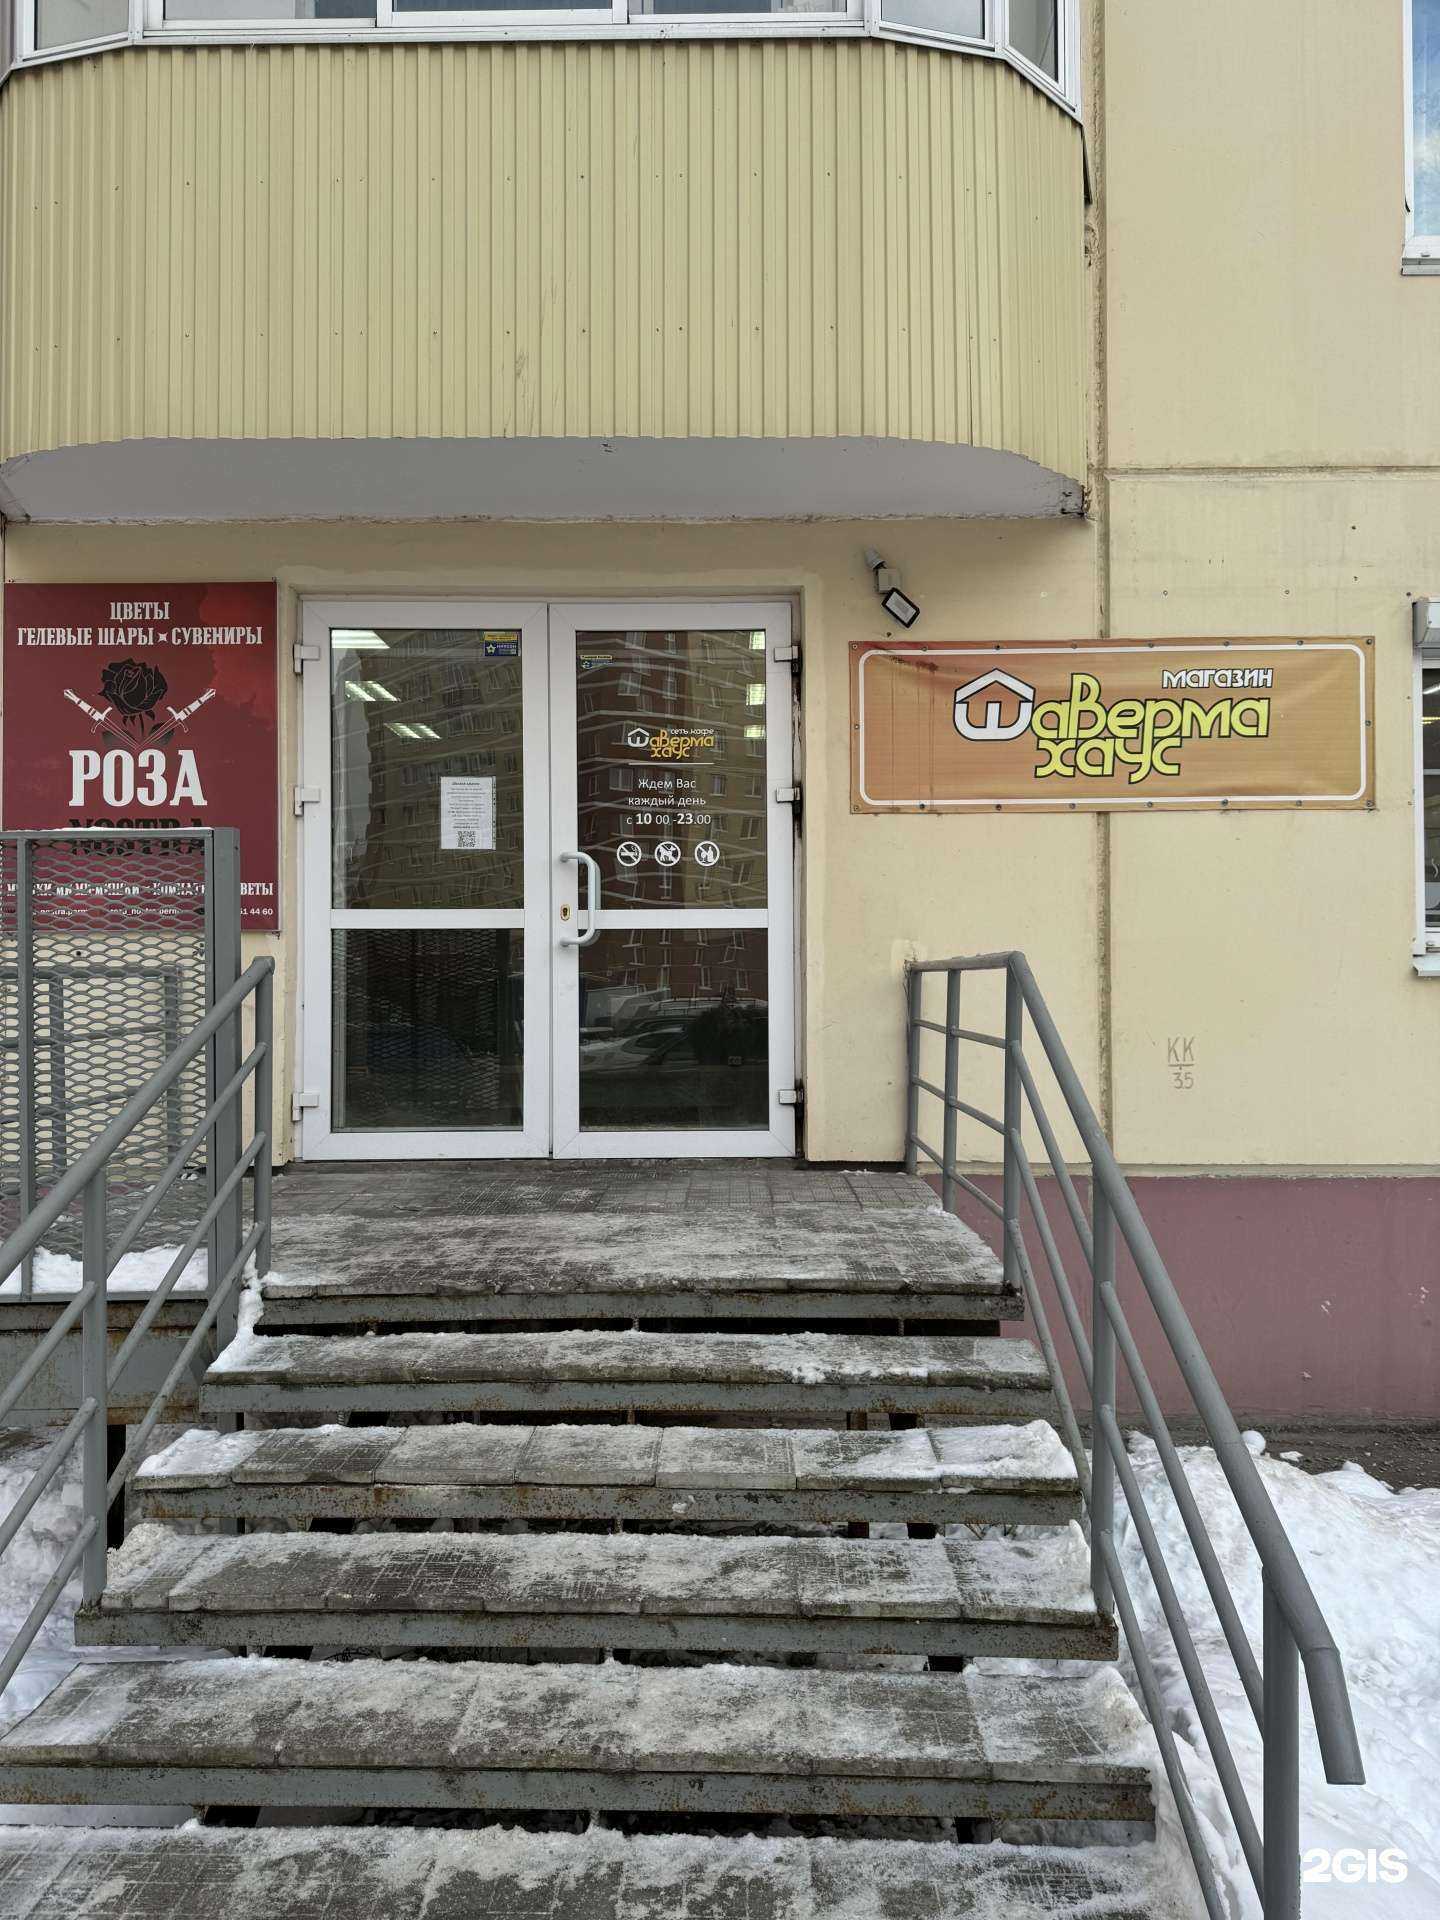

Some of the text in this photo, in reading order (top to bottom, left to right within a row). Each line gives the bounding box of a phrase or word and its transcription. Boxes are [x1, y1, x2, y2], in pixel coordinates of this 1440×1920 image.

[110, 601, 170, 623] ЦВЕТЫ
[17, 626, 263, 646] ГЕЛЕВЫЕ ШАРЫ СУВЕНИРЫ
[68, 749, 208, 808] РОЗА
[638, 778, 697, 791] Ждем Вас
[628, 794, 707, 807] каждый день
[636, 813, 652, 825] 10
[240, 882, 274, 896] ВЕТЫ
[249, 907, 261, 916] 44
[262, 907, 274, 916] 60
